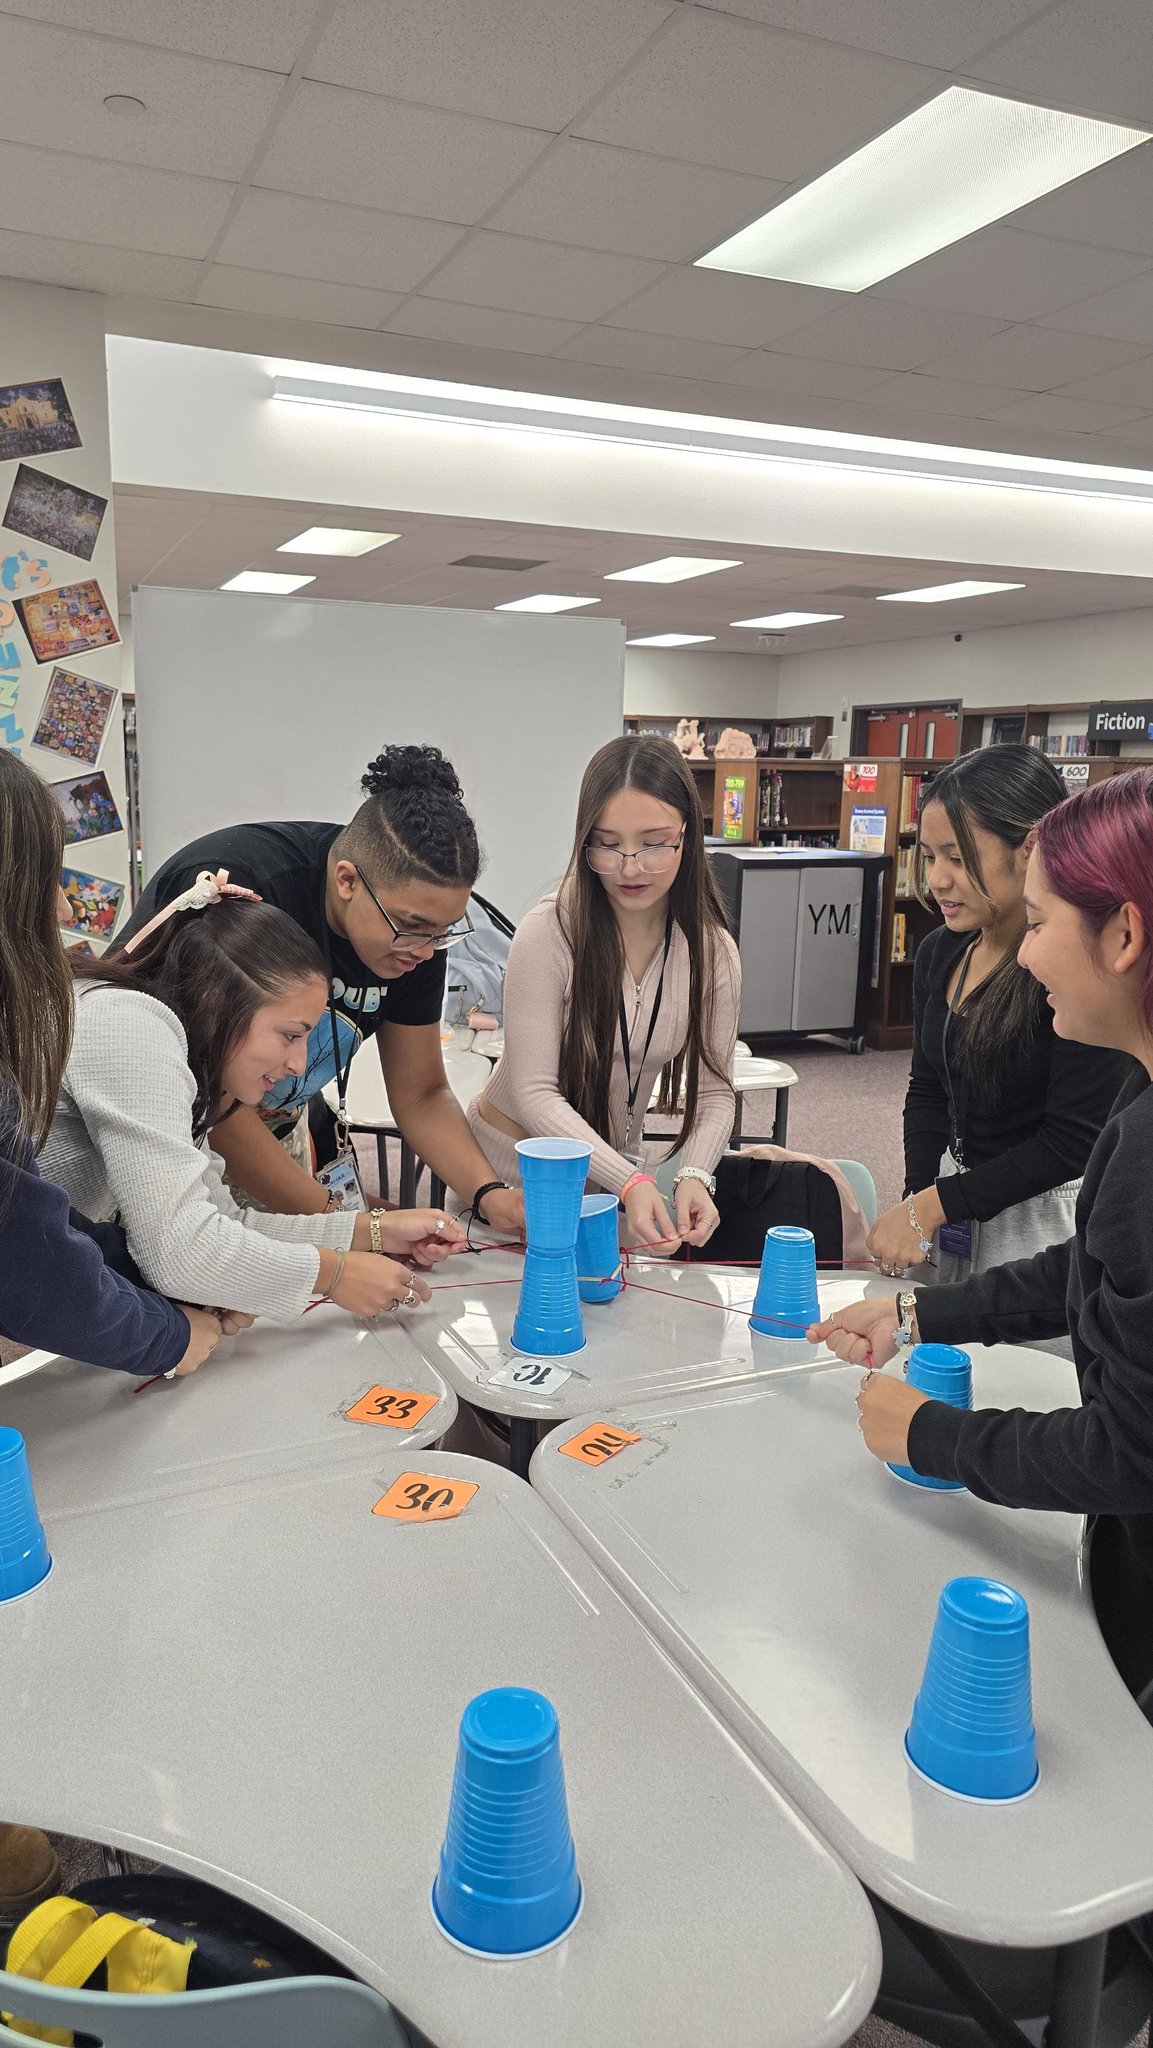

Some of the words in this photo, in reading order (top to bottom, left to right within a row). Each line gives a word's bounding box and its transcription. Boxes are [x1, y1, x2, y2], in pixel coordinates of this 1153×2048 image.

[1096, 711, 1146, 731] Fiction
[1066, 766, 1088, 777] 600
[808, 903, 852, 935] YM
[365, 1395, 419, 1420] 33
[395, 1483, 455, 1513] 30
